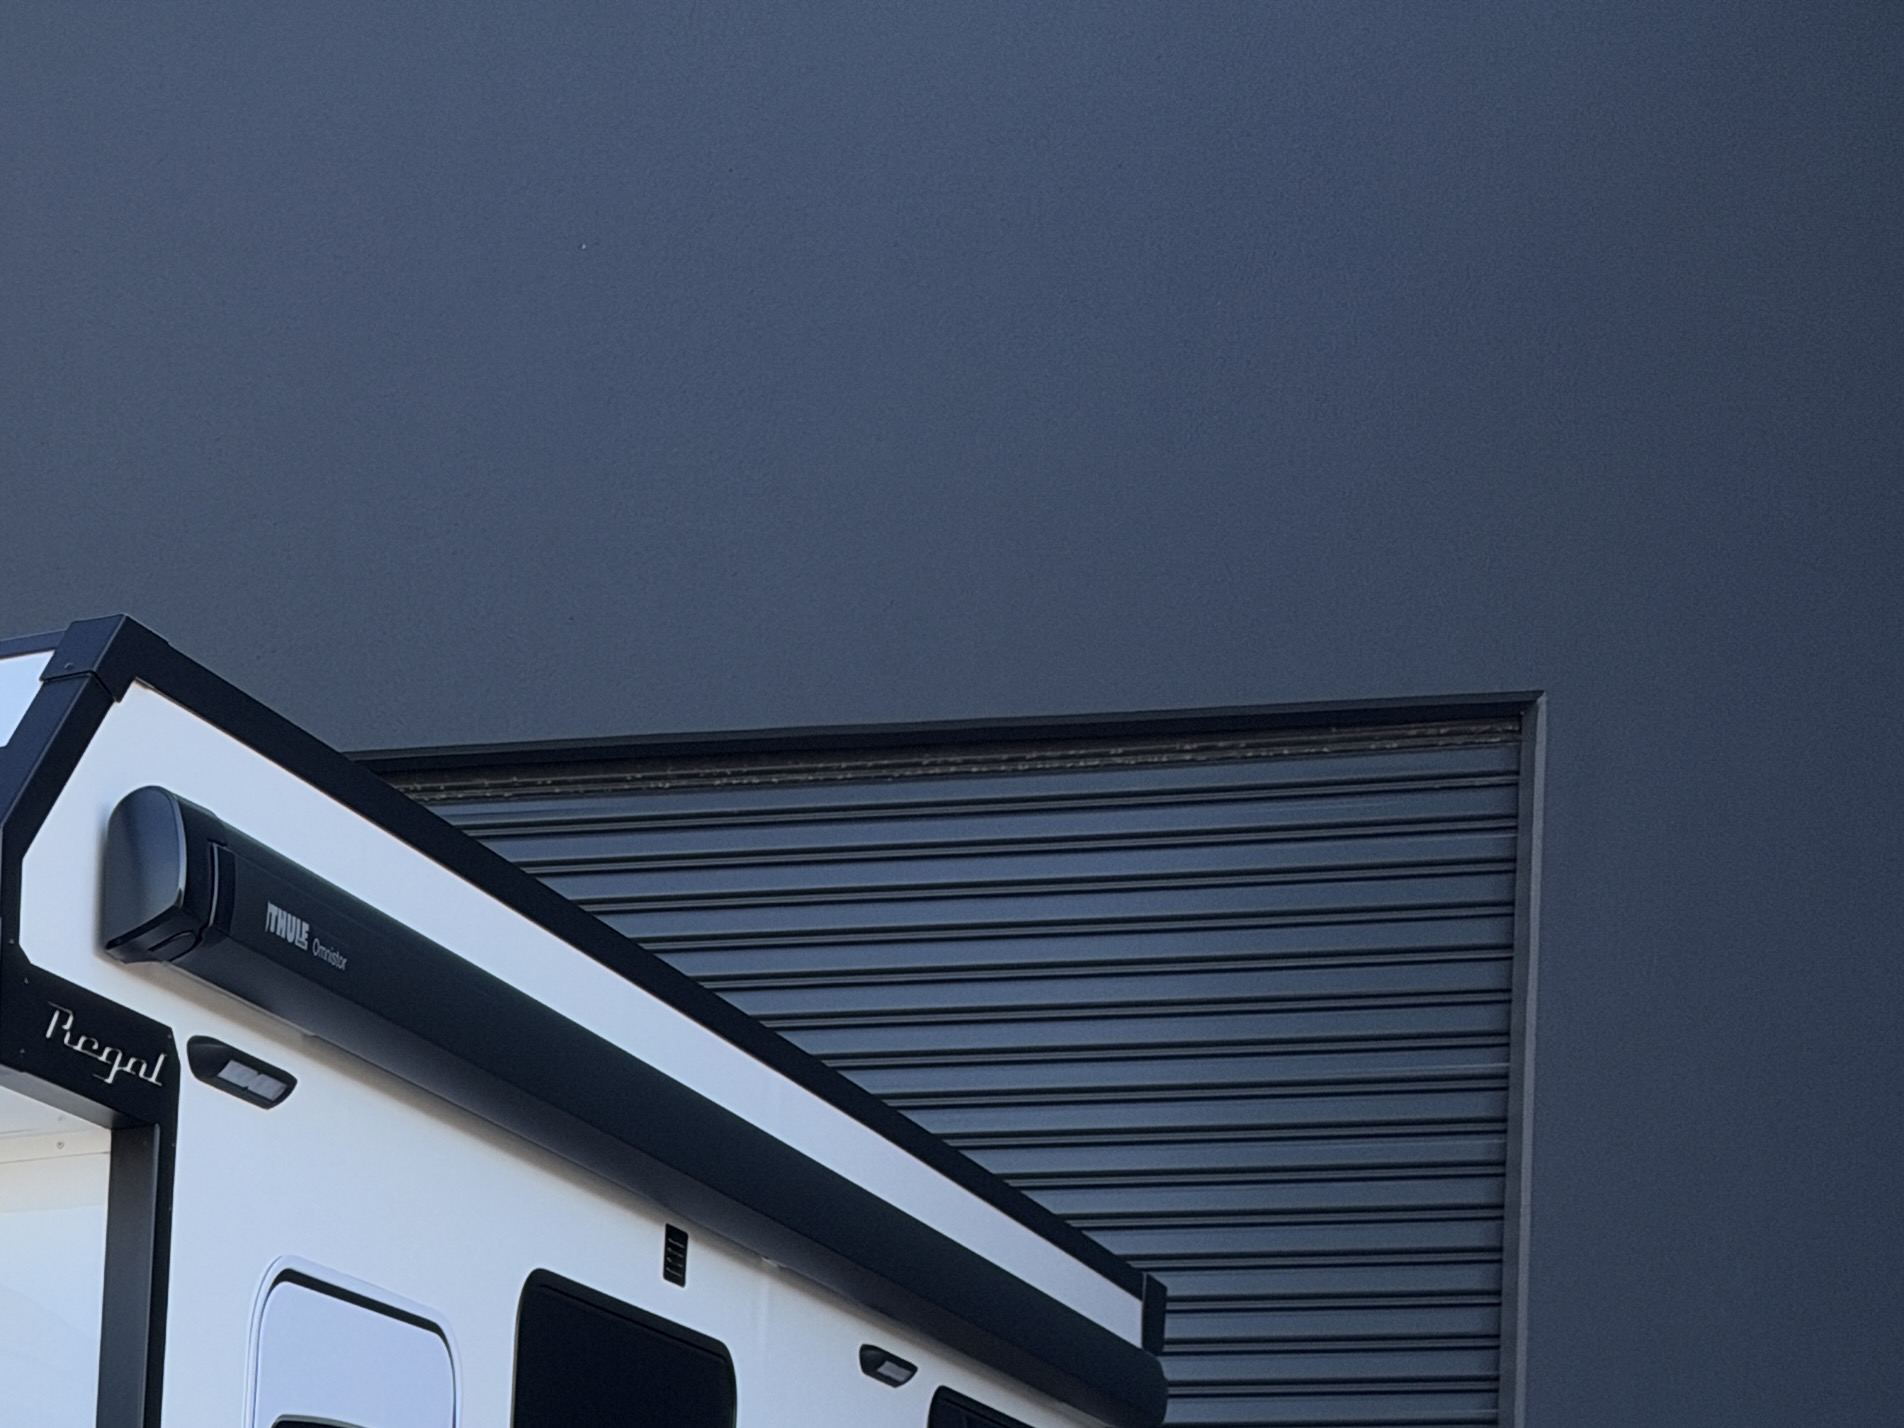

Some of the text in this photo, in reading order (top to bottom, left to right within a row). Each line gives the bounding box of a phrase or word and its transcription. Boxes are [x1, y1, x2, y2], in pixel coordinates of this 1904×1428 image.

[265, 901, 348, 971] THULE Omnistor
[45, 1001, 168, 1087] Regal
